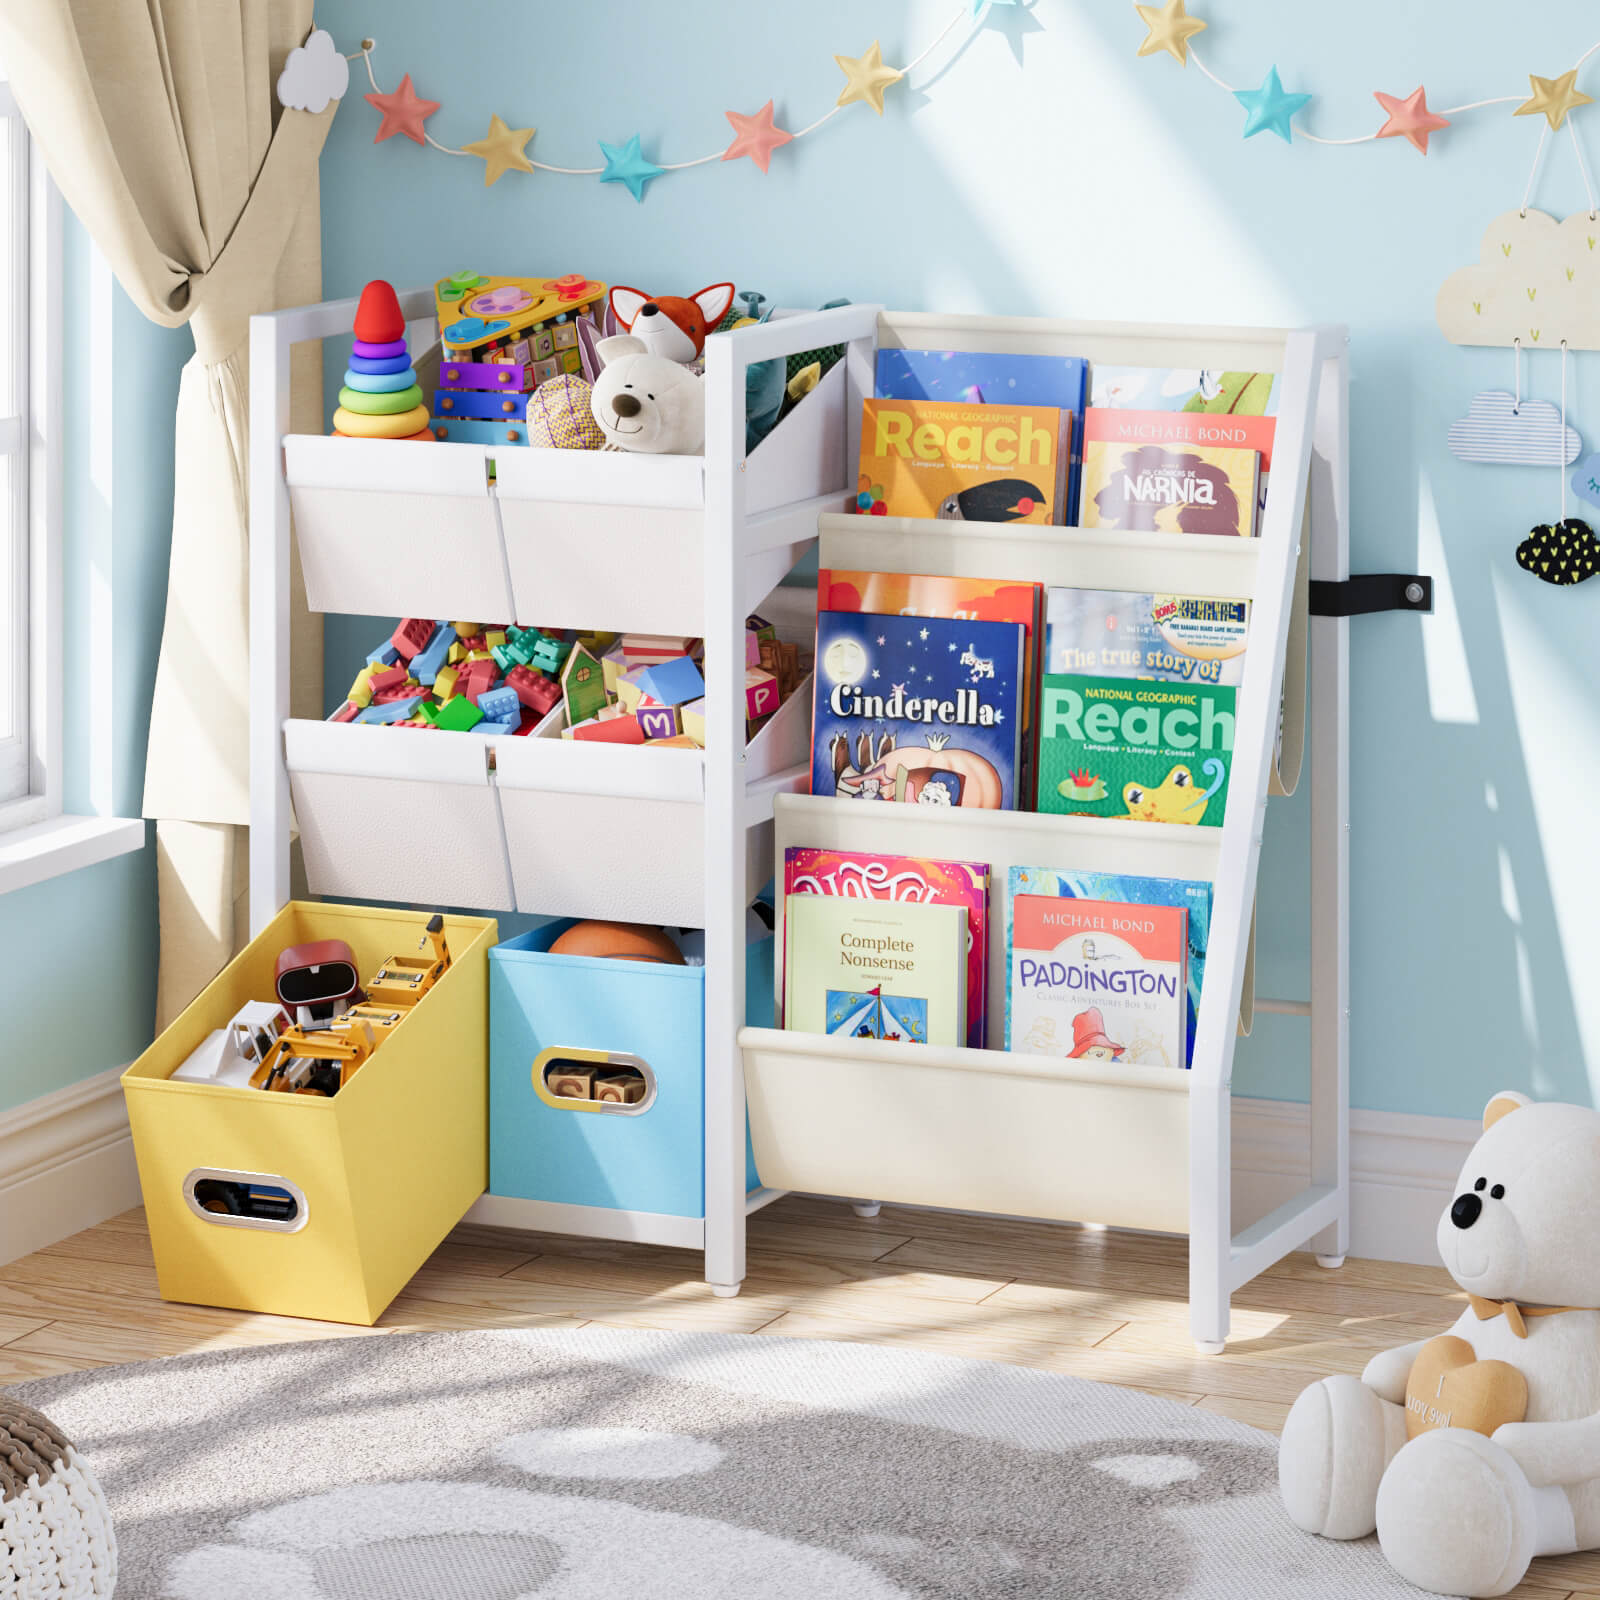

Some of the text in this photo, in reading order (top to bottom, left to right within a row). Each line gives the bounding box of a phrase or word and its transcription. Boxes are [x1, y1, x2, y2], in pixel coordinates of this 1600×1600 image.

[875, 410, 1052, 465] Reach
[1118, 424, 1247, 443] MICHAEL BOND
[1062, 648, 1222, 683] The true story of
[754, 688, 770, 713] P
[830, 683, 994, 726] Cinderella
[1085, 688, 1197, 705] NATIONAL GEOGRAPHIC
[643, 713, 670, 737] M
[1043, 688, 1235, 751] Reach
[1083, 743, 1195, 757] Language Literacy Content
[1043, 913, 1155, 933] MICHAEL BOND
[841, 933, 915, 953] Complete
[840, 952, 915, 971] Nonsense
